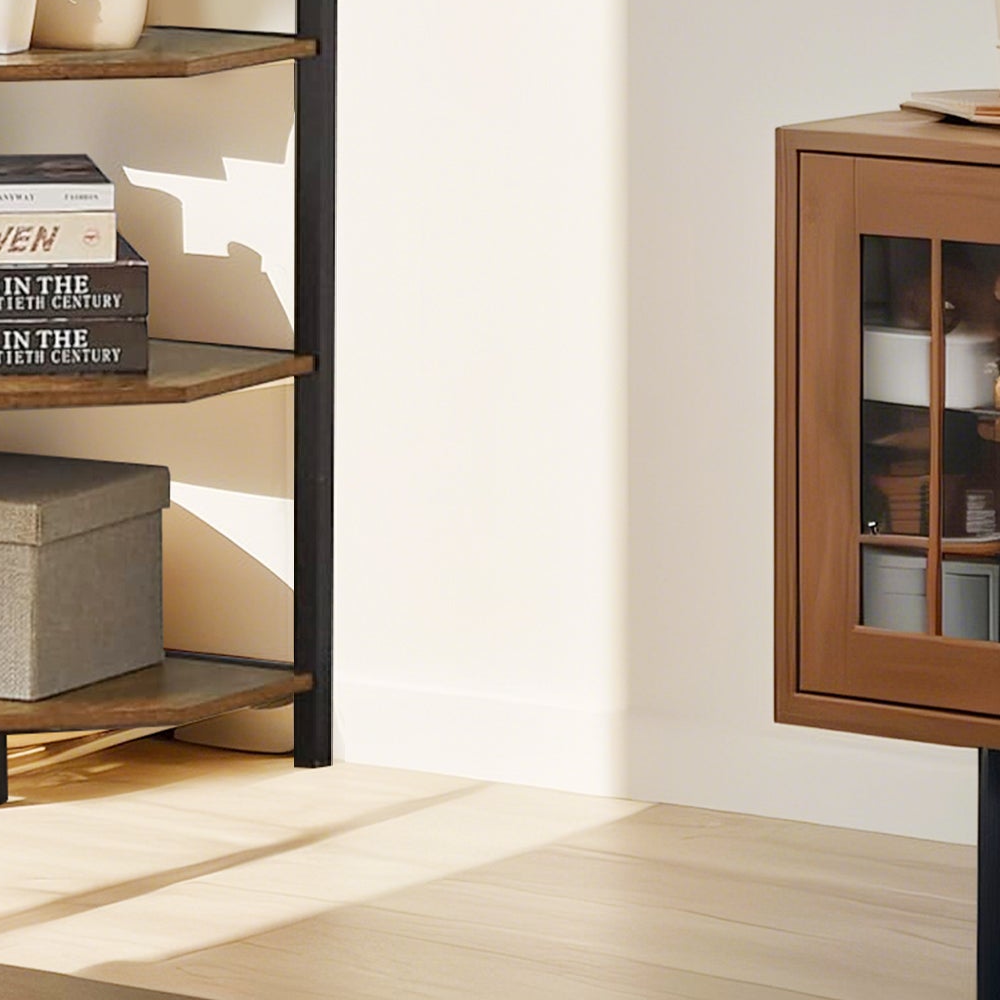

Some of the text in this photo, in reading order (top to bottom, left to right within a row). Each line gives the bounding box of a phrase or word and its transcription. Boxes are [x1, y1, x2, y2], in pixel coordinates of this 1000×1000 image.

[4, 276, 31, 296] IN
[36, 275, 89, 294] THE
[51, 293, 122, 309] CENTURY
[3, 330, 31, 350] IN
[35, 329, 89, 349] THE
[50, 348, 122, 364] CENTURY
